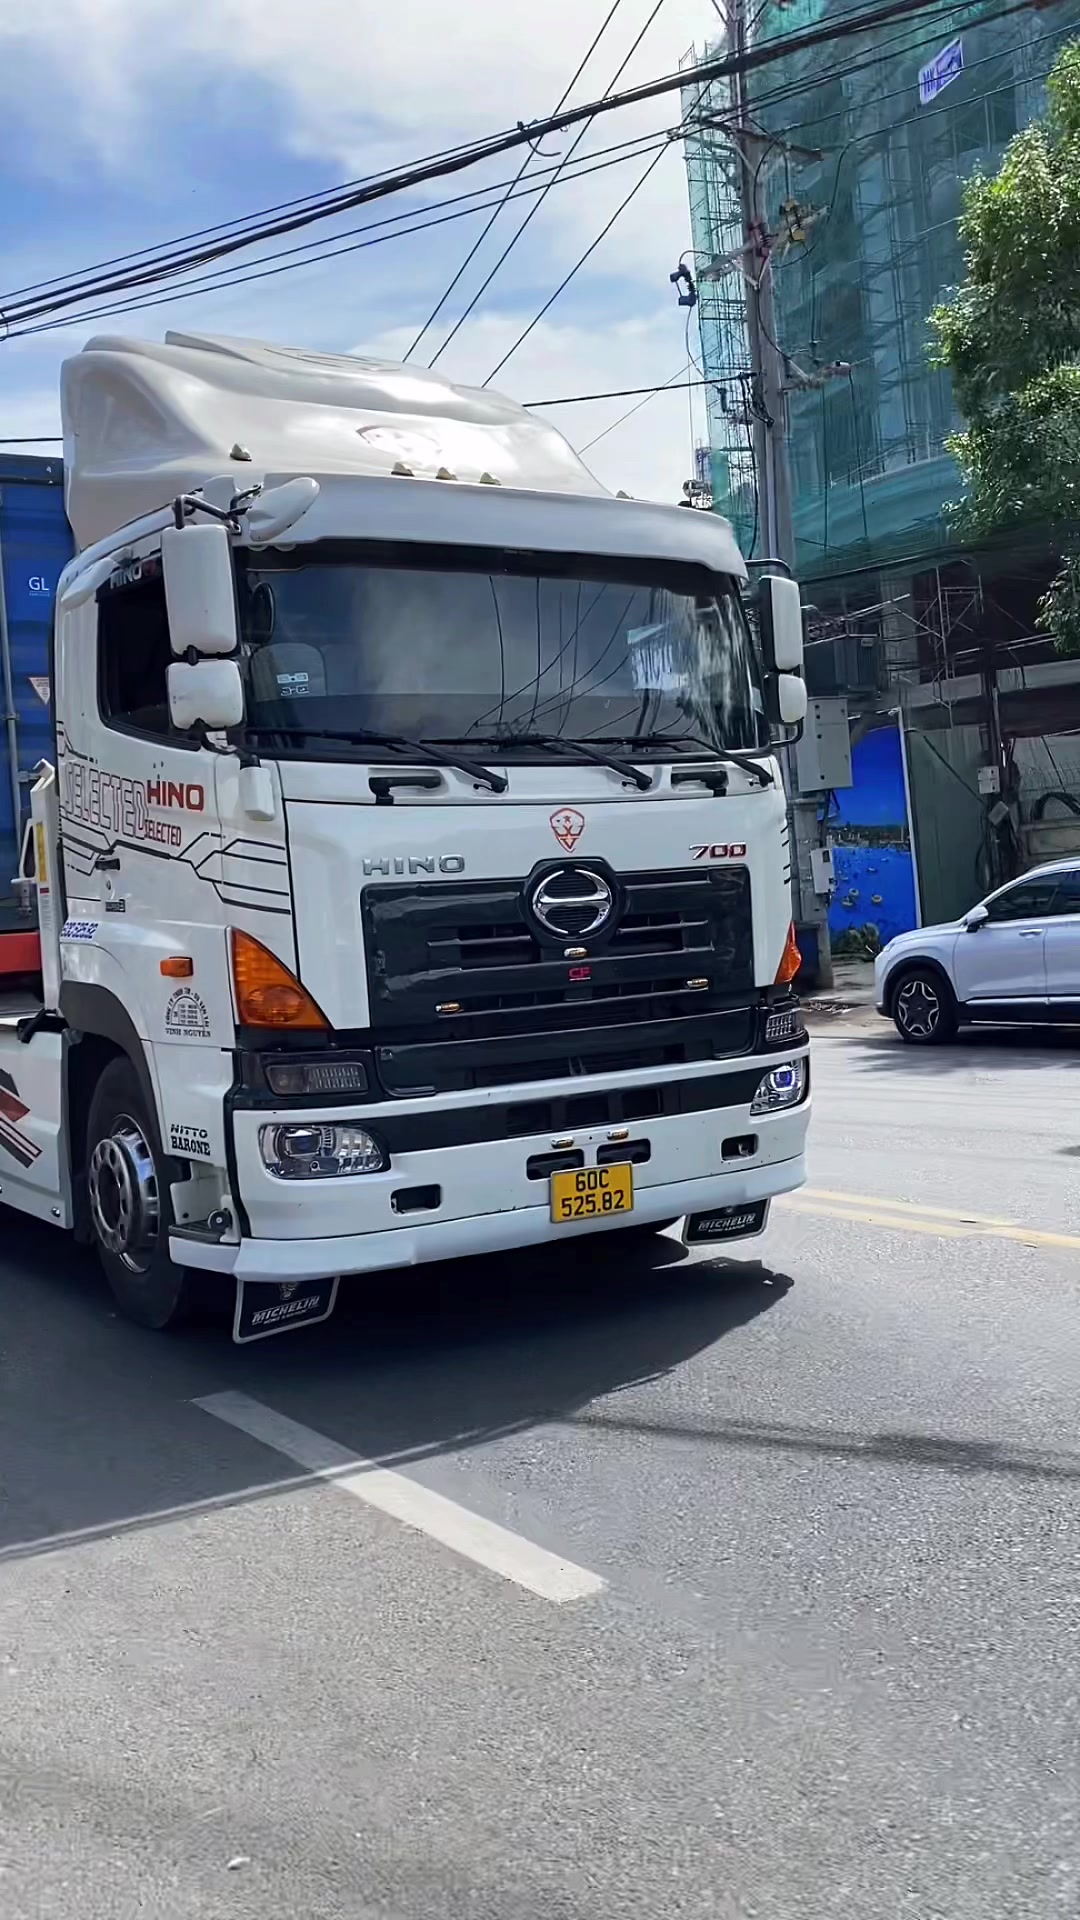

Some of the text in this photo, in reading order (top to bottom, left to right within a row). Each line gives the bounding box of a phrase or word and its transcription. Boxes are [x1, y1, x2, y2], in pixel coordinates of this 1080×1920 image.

[64, 761, 149, 840] SELECTED
[147, 779, 204, 812] HINO
[144, 819, 182, 847] SELECTED
[689, 841, 747, 860] 700
[362, 854, 465, 876] HINO
[170, 1123, 208, 1139] NITTO
[171, 1135, 211, 1156] BARONE
[575, 1169, 609, 1192] 60C
[561, 1189, 625, 1217] 525.82
[697, 1212, 756, 1231] MICHELIN
[251, 1295, 320, 1324] MICHELIN
